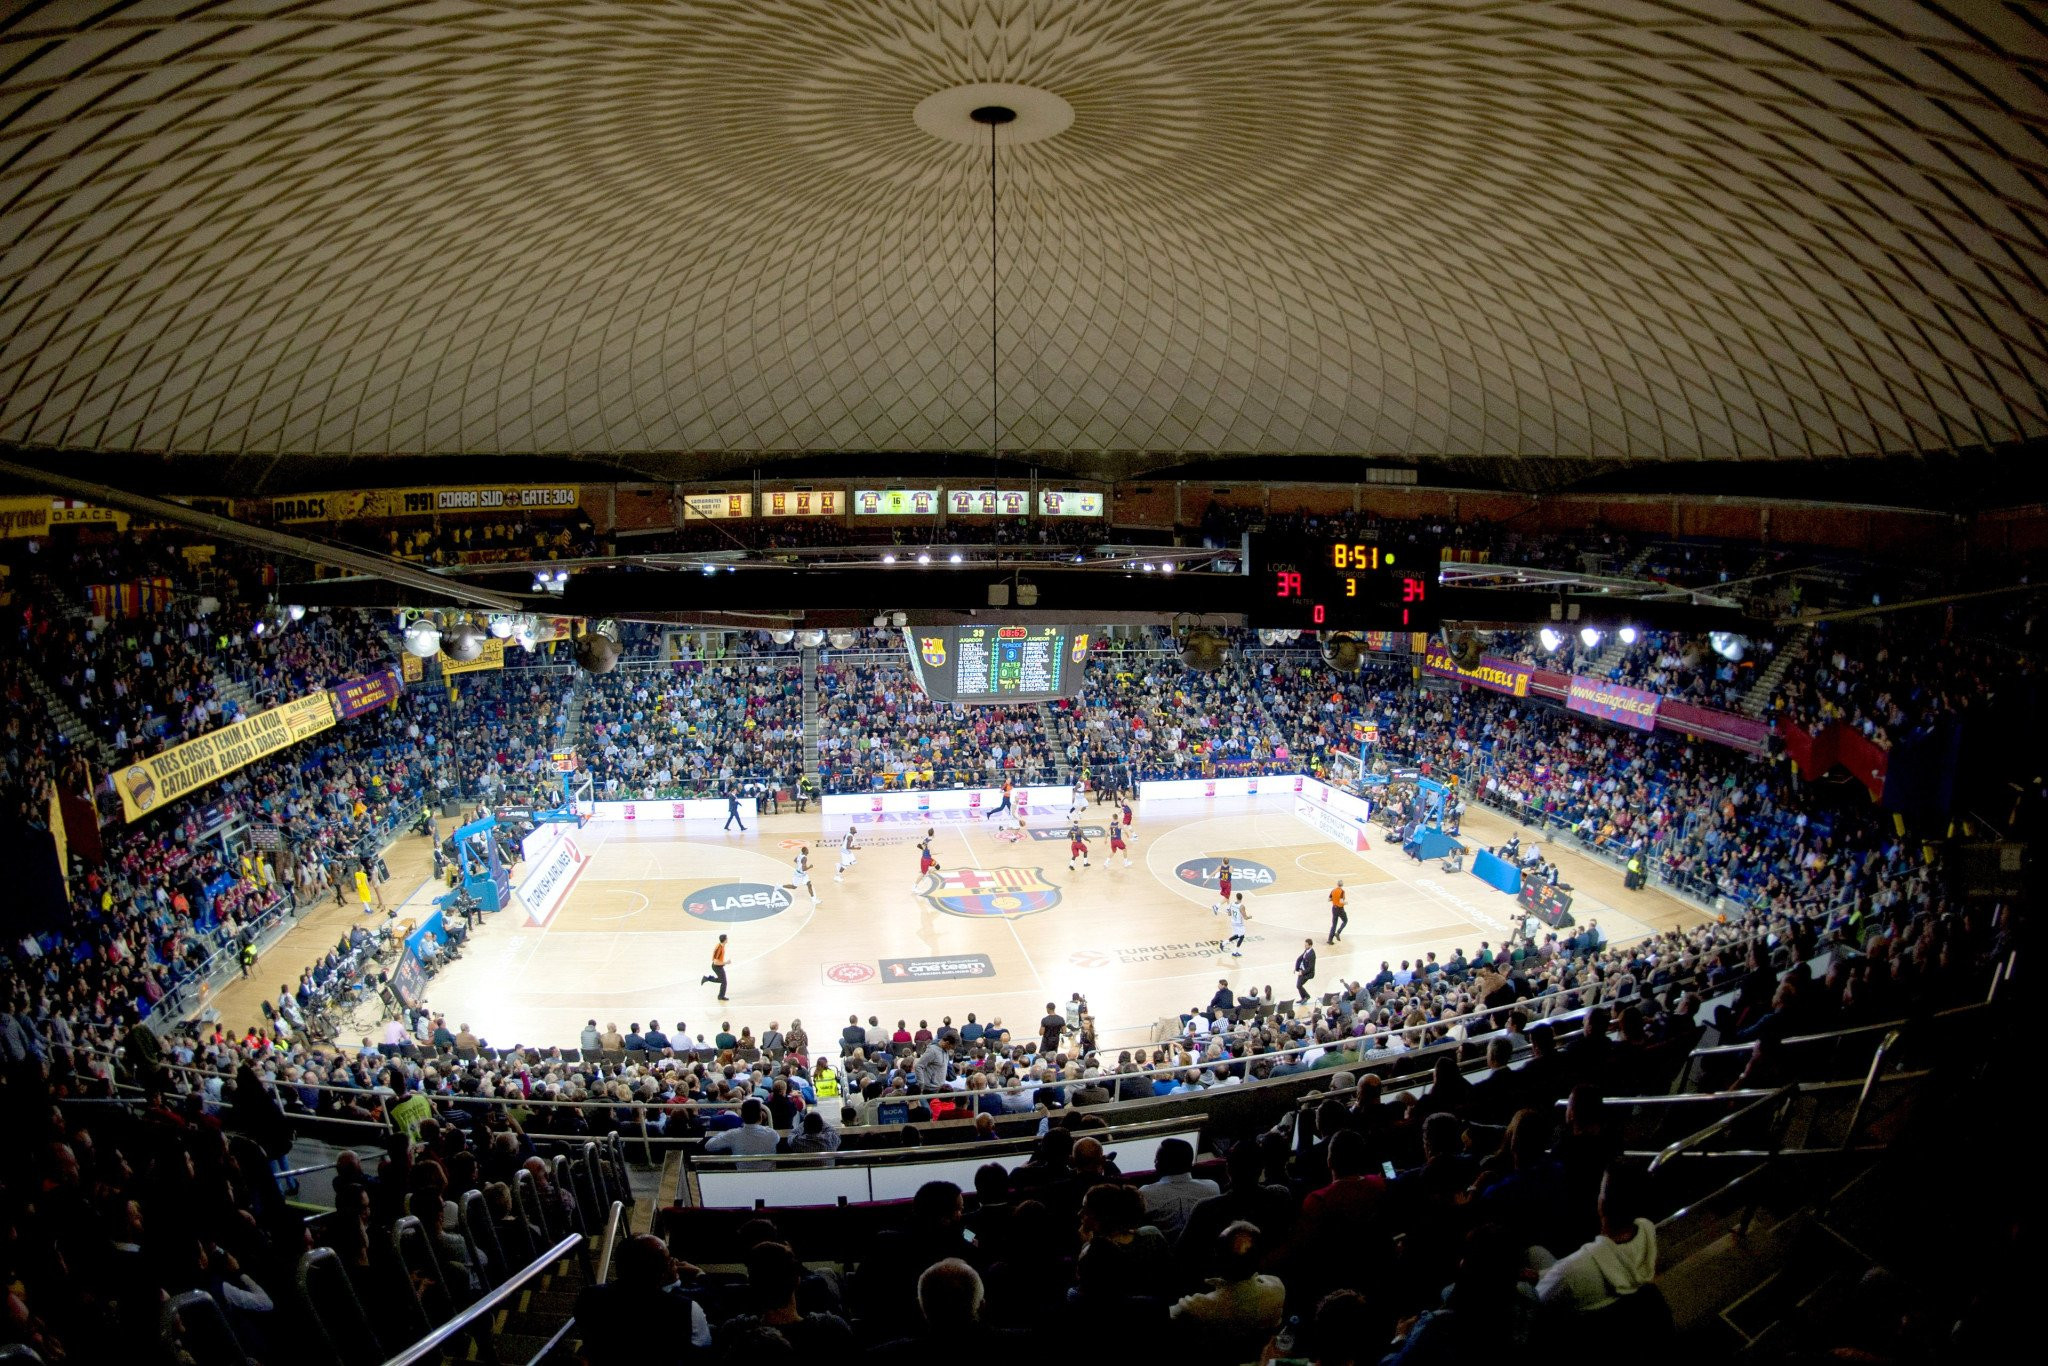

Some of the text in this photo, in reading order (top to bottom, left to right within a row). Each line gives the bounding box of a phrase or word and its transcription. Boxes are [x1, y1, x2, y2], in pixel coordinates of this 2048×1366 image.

[404, 493, 435, 511] 1991
[480, 489, 504, 507] SUD
[522, 488, 575, 506] GATE 304
[893, 497, 901, 505] 16
[273, 498, 325, 519] DRACS
[1267, 559, 1298, 573] LOCAL
[1335, 543, 1378, 570] 8:51
[1277, 571, 1302, 598] 39
[1391, 570, 1426, 581] VISITANT
[1346, 578, 1357, 597] 3
[1402, 576, 1425, 602] 34
[1313, 604, 1325, 624] 0
[1403, 608, 1409, 625] 1
[973, 629, 985, 638] 39
[1044, 628, 1057, 636] 34
[1570, 685, 1657, 717] www.sangcule.cat
[151, 710, 283, 779] TRES COSES TENIM A LA VIDA
[160, 758, 221, 799] CATALUNYA,
[250, 740, 258, 756] I
[256, 726, 290, 753] DRACS!
[526, 850, 571, 911] TURKISH AIRLINES
[711, 889, 789, 911] LASSA
[1115, 942, 1193, 956] TURKISH
